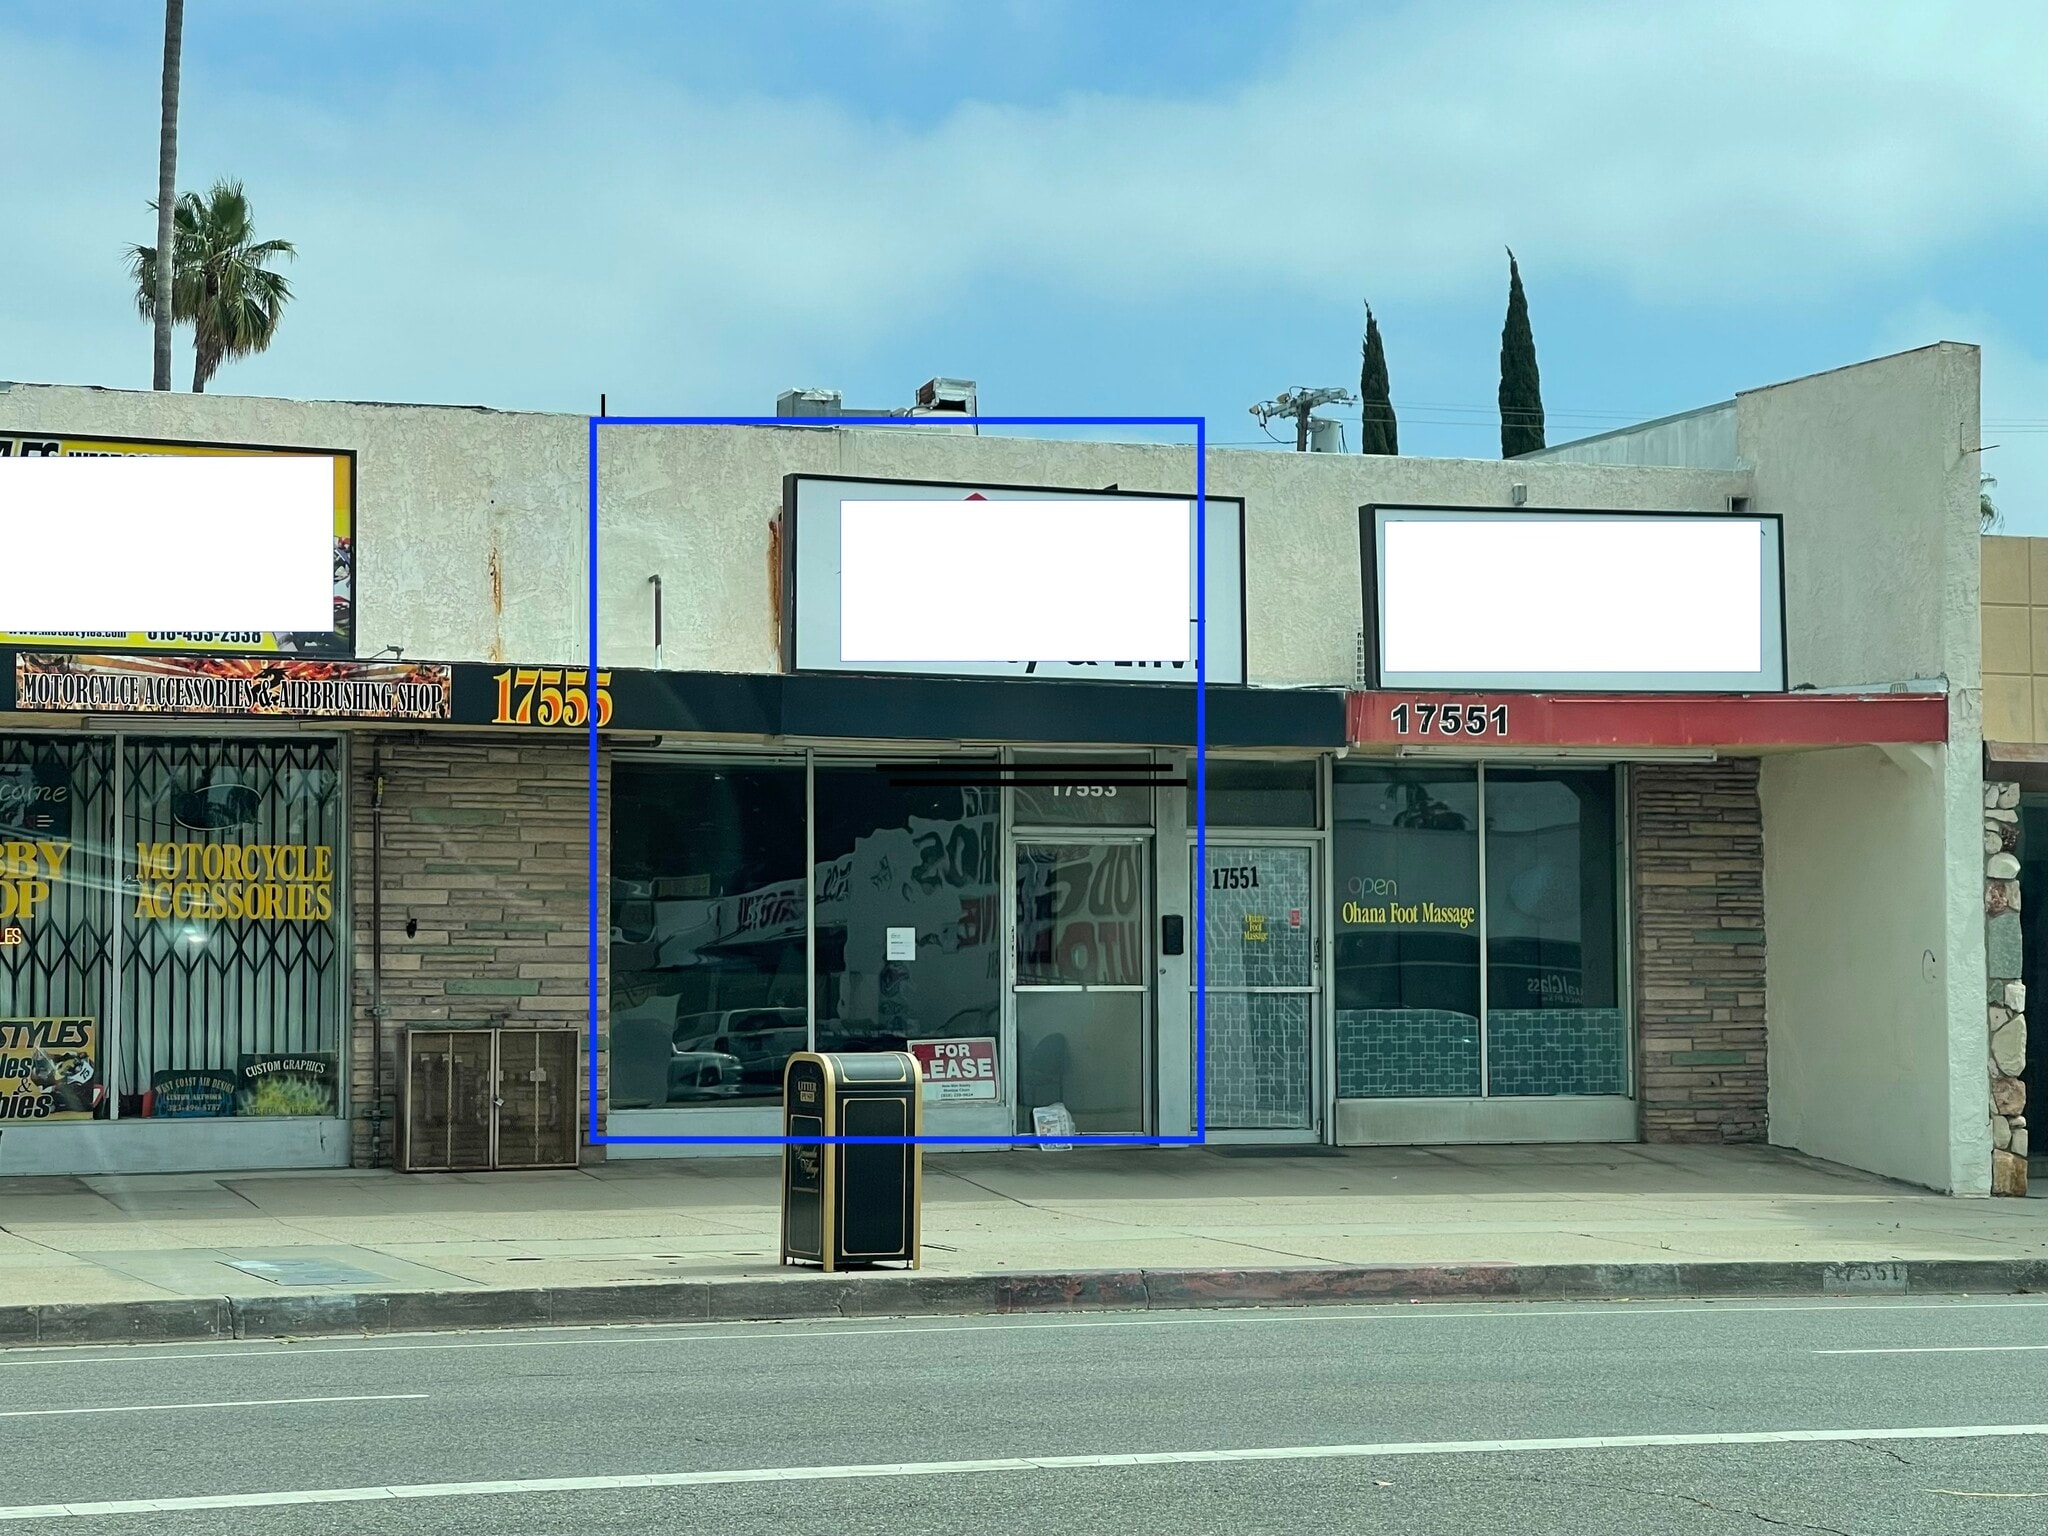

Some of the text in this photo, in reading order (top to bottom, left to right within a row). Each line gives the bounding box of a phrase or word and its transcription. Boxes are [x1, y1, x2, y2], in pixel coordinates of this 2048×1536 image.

[23, 673, 443, 714] MOTORCYLCE ACCESSORIES & AIRBRUSHING SHOP
[492, 667, 613, 727] 17555
[1391, 703, 1507, 736] 17551
[0, 842, 71, 878] BY
[136, 842, 332, 881] MOTORCYCLE
[1213, 866, 1259, 889] 17551
[134, 882, 332, 921] ACCESSORIES
[1343, 901, 1475, 928] Ohana Foot Massage
[0, 928, 21, 945] ES
[935, 1044, 970, 1058] FOR
[245, 1059, 326, 1078] CUSTOM GRAPHICS
[18, 1079, 32, 1093] &
[155, 1080, 174, 1094] WEST
[175, 1076, 197, 1088] COAST
[199, 1076, 211, 1087] AIR
